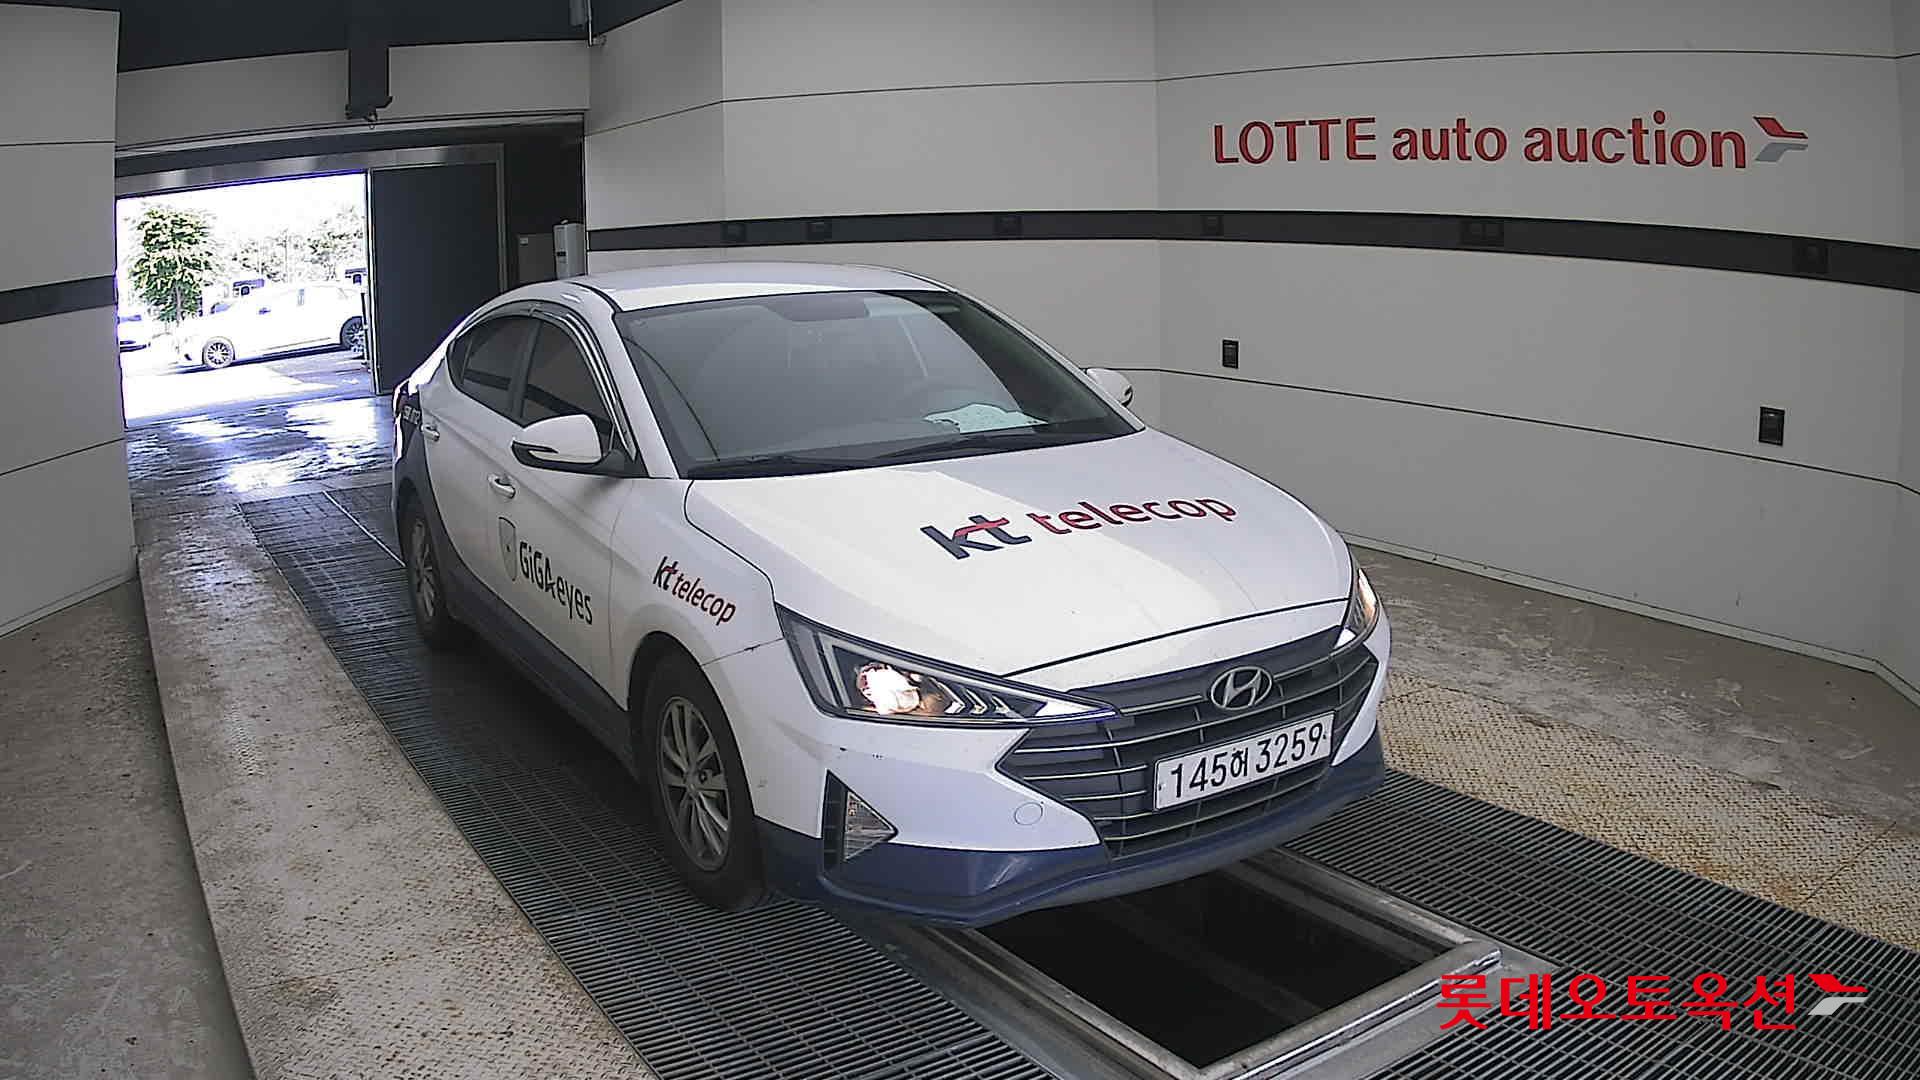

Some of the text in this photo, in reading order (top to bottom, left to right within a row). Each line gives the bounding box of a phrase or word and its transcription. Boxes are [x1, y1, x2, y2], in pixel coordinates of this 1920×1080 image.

[1213, 110, 1746, 169] LOTTE auto auction
[920, 498, 1237, 560] kt telecop
[652, 555, 737, 626] kt telecop
[1255, 722, 1323, 774] 3259
